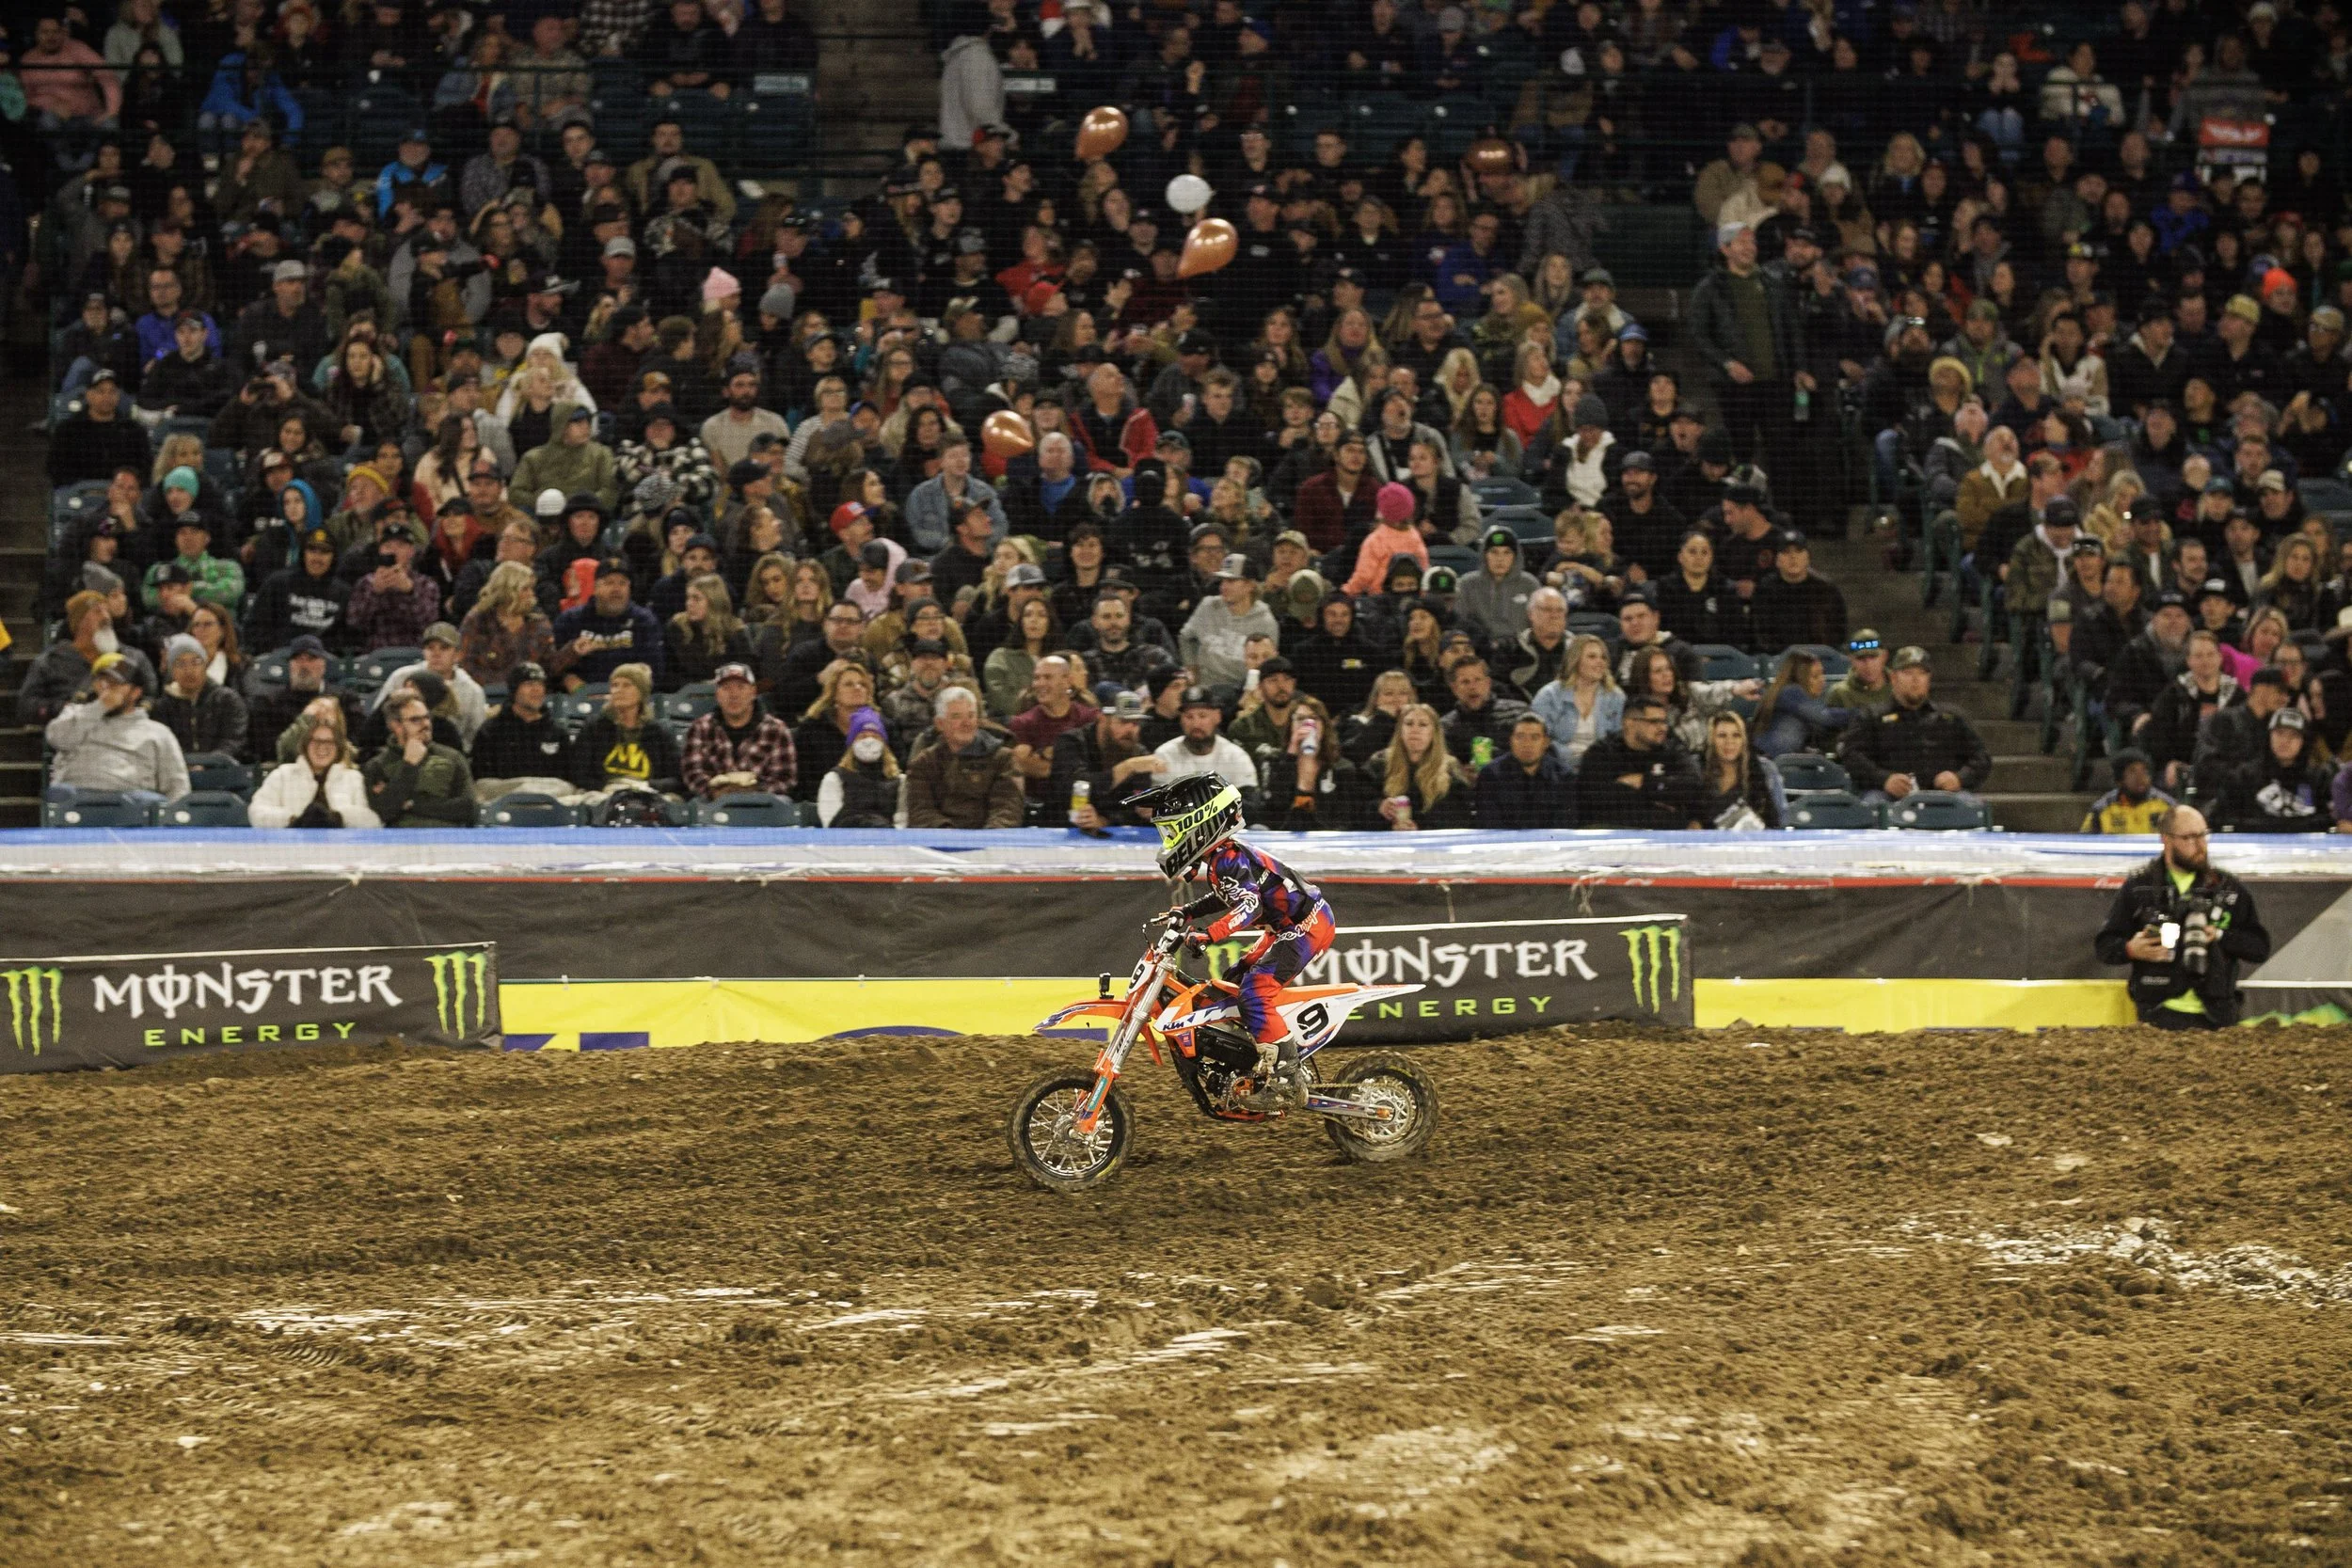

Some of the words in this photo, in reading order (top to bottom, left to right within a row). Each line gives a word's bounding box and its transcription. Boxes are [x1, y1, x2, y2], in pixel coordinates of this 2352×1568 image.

[1176, 800, 1218, 832] 100%
[1166, 829, 1206, 879] BELL
[1129, 963, 1145, 989] 9
[1293, 937, 1598, 988] MONSTER
[93, 961, 403, 1020] MONSTER
[145, 1022, 356, 1047] ENERGY
[1163, 1022, 1184, 1031] KTM
[1296, 1003, 1328, 1040] 9
